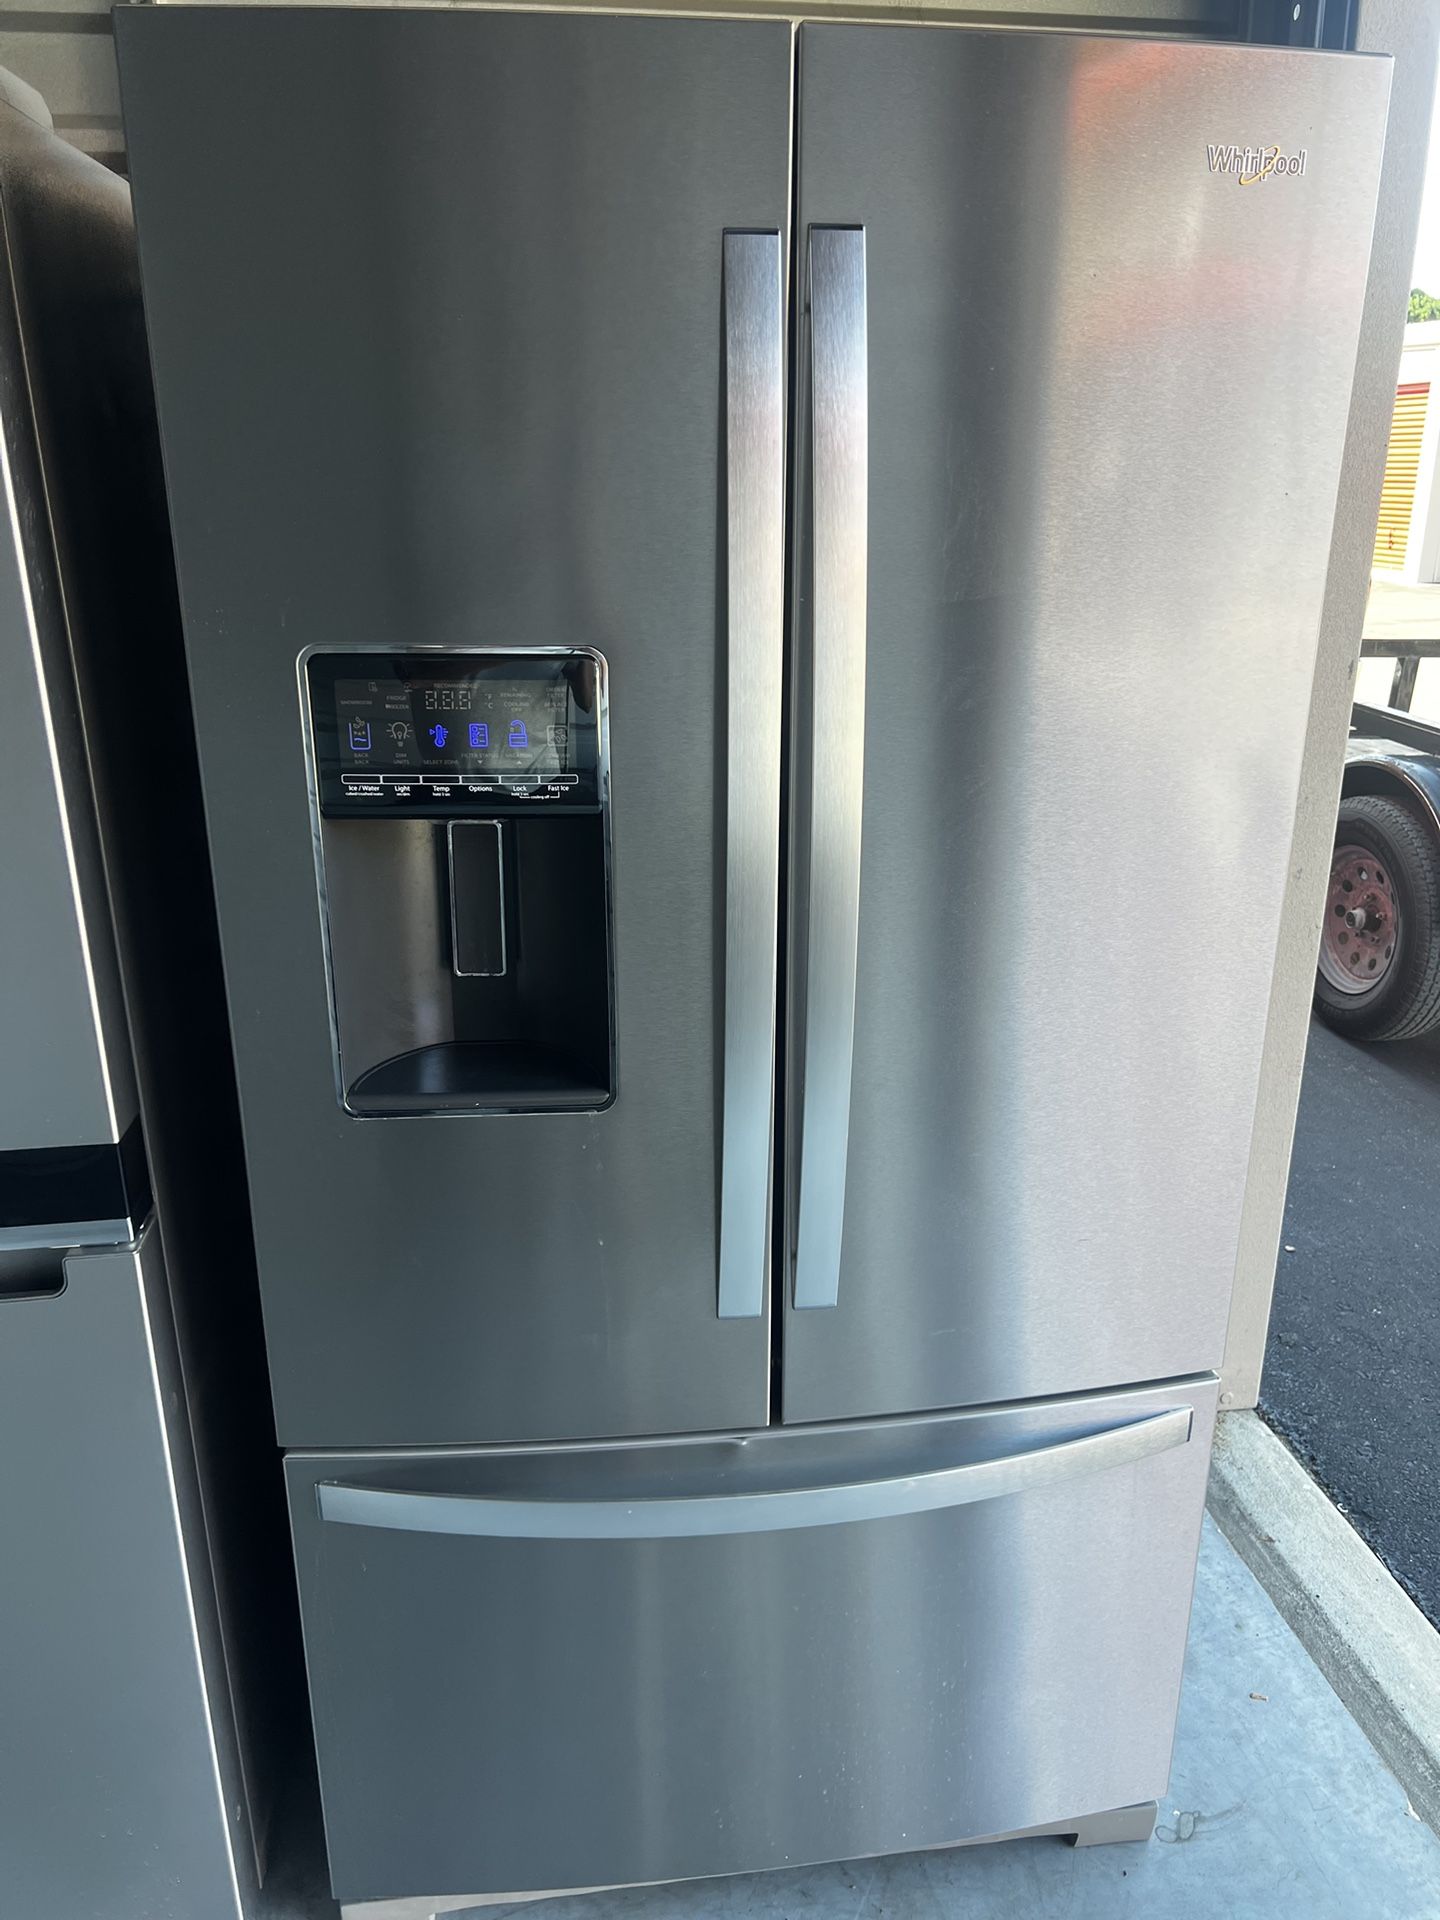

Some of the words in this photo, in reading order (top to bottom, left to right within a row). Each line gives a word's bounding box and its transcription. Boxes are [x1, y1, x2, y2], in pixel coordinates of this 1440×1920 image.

[1207, 144, 1308, 182] Whirlpool
[394, 785, 410, 793] Light
[432, 785, 450, 793] Temp
[468, 785, 493, 793] Options
